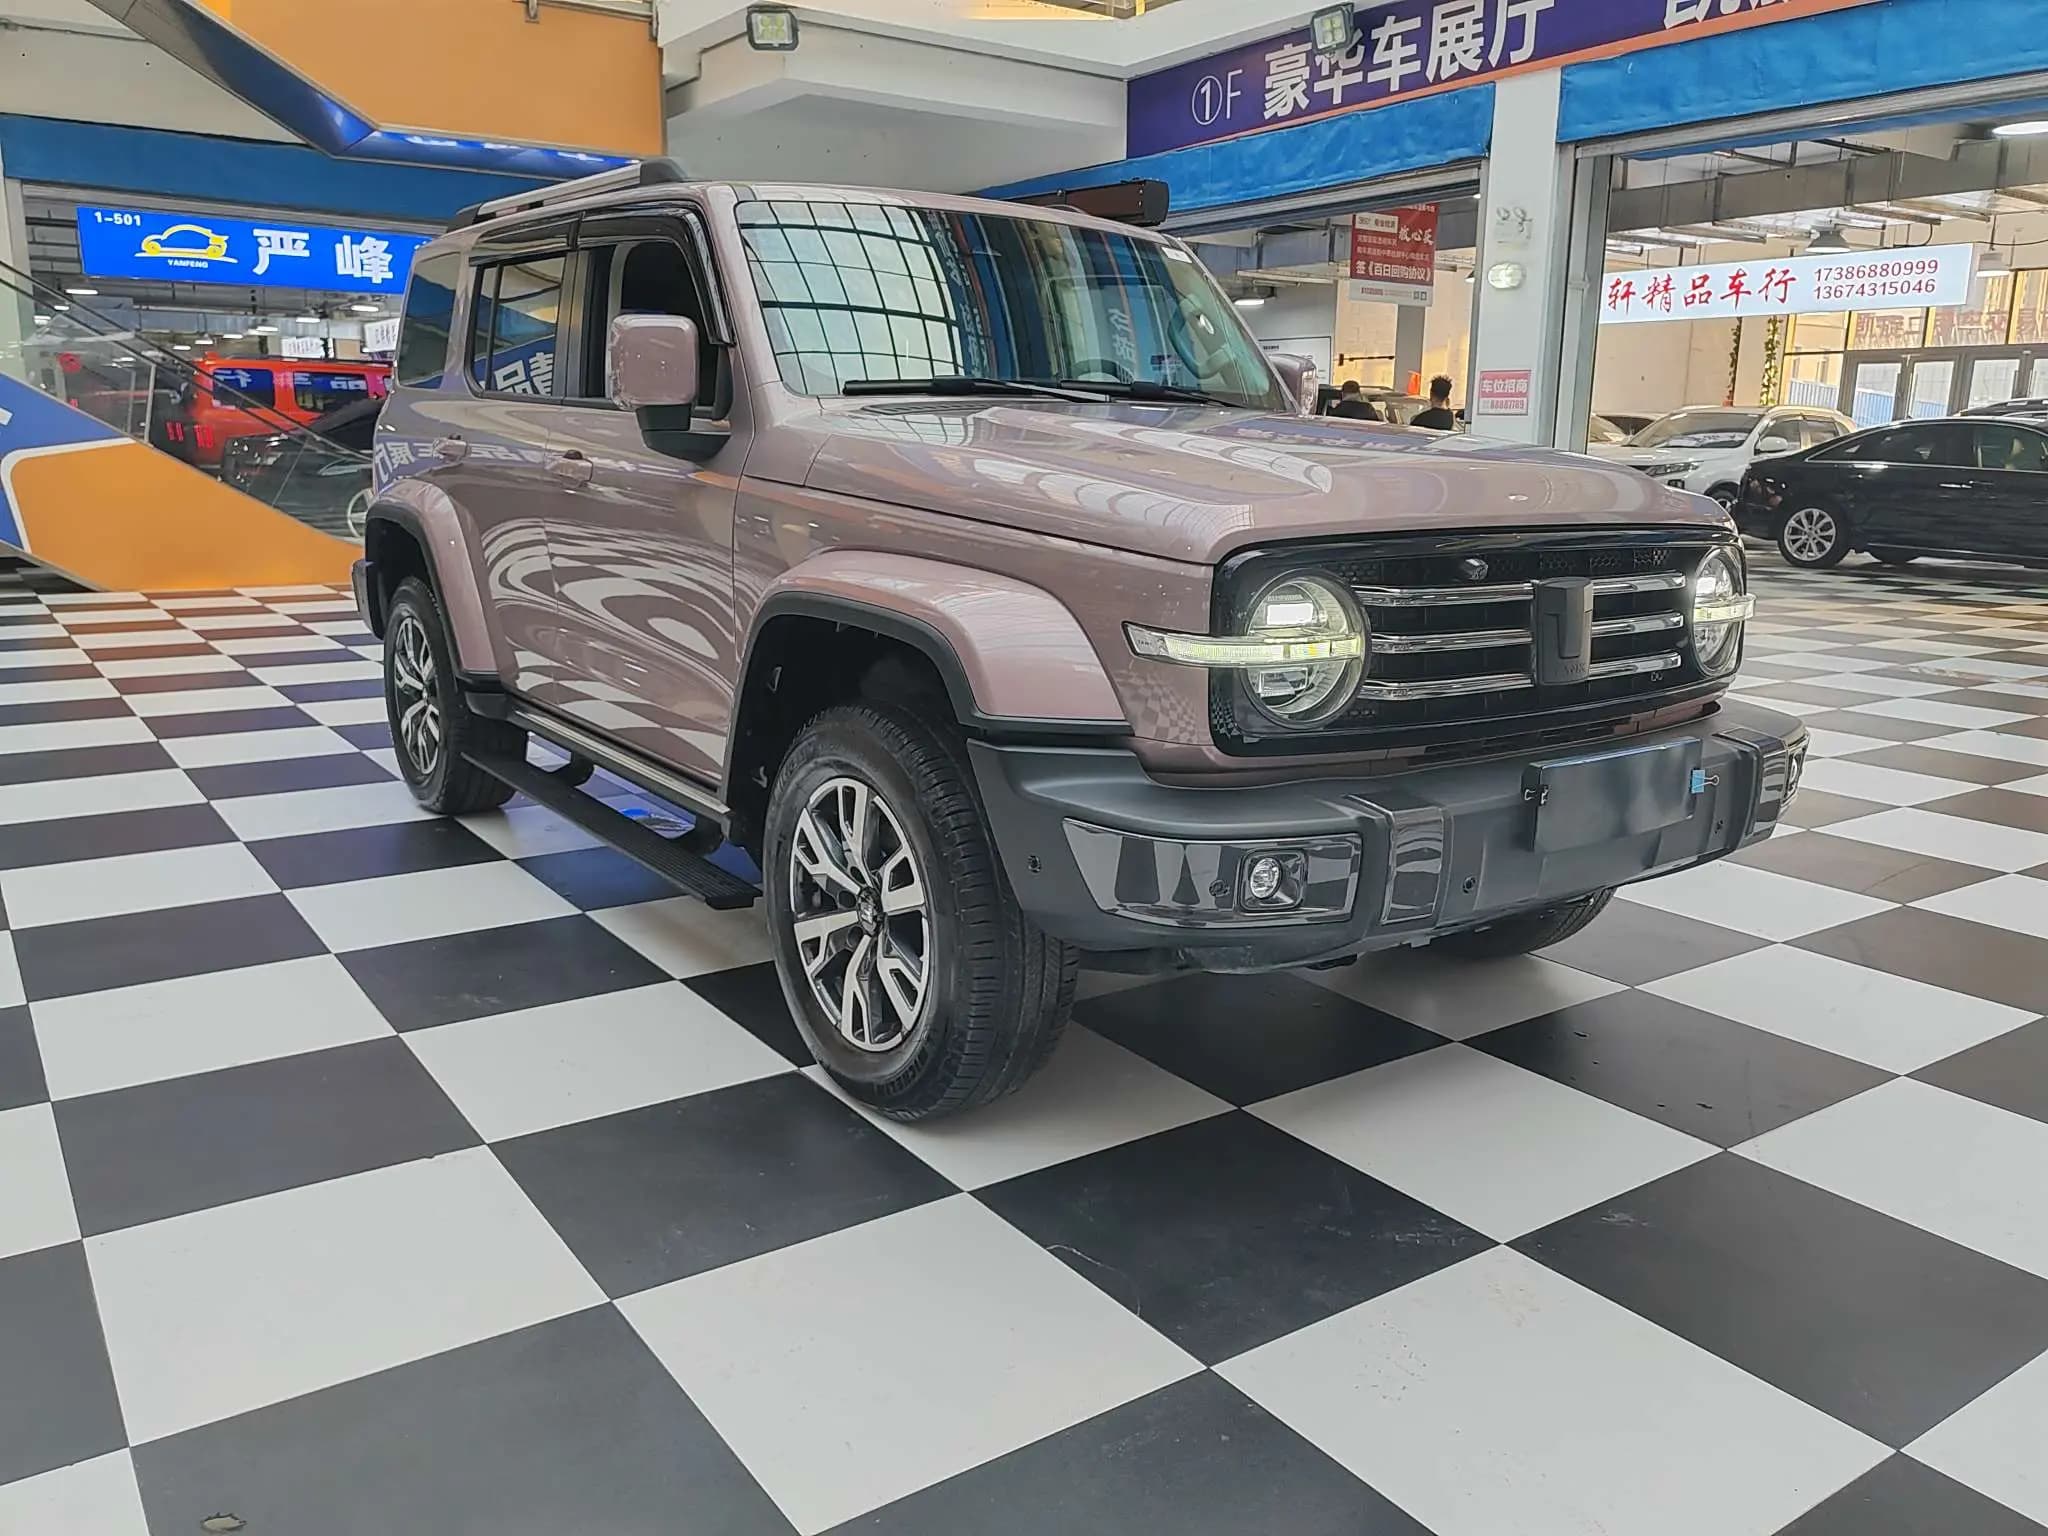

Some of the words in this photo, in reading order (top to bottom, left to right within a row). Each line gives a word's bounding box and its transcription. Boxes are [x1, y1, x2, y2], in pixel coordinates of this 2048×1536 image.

[1263, 0, 1555, 120] 豪华车展厅
[94, 211, 141, 227] 1-501
[252, 228, 432, 284] 严峰
[1814, 259, 1939, 282] 17386880999
[1608, 267, 1797, 315] 轩精品车行
[1814, 278, 1936, 300] 13674315046
[1481, 378, 1528, 393] 车位招商
